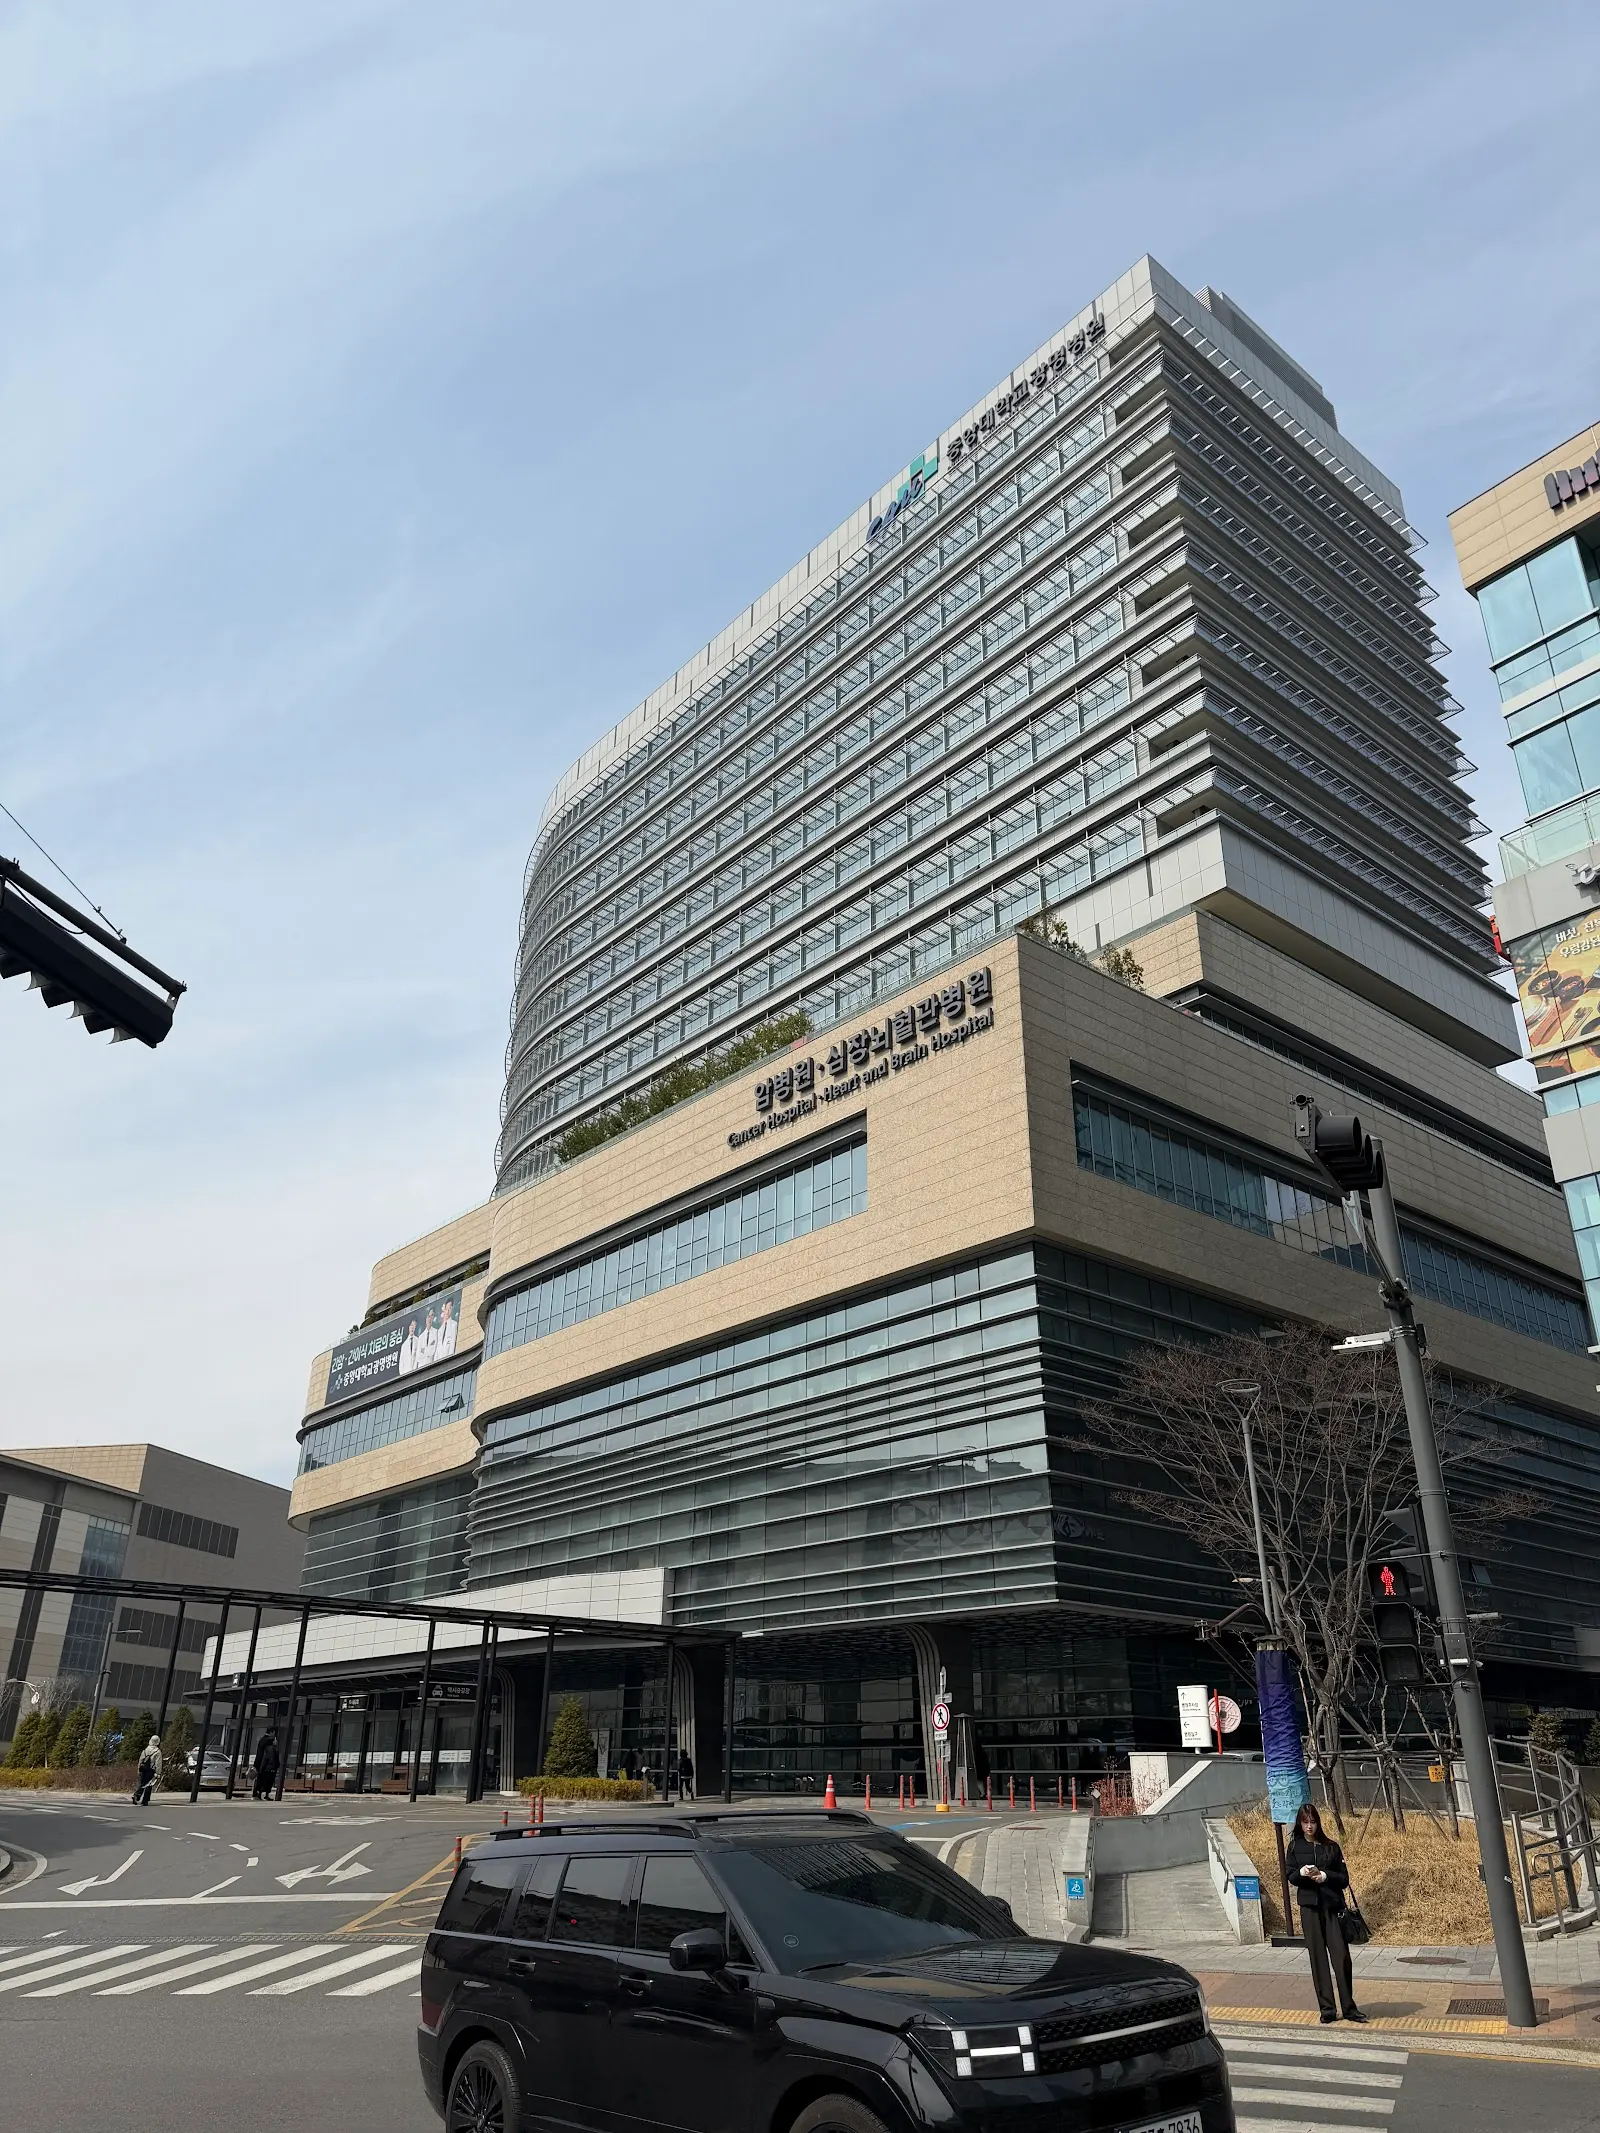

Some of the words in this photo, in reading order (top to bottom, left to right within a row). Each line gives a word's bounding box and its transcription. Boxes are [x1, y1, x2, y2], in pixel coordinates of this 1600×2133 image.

[726, 1123, 766, 1147] Cancer
[862, 1059, 889, 1085] and
[890, 1041, 929, 1070] Brain
[930, 1006, 994, 1052] Hospital
